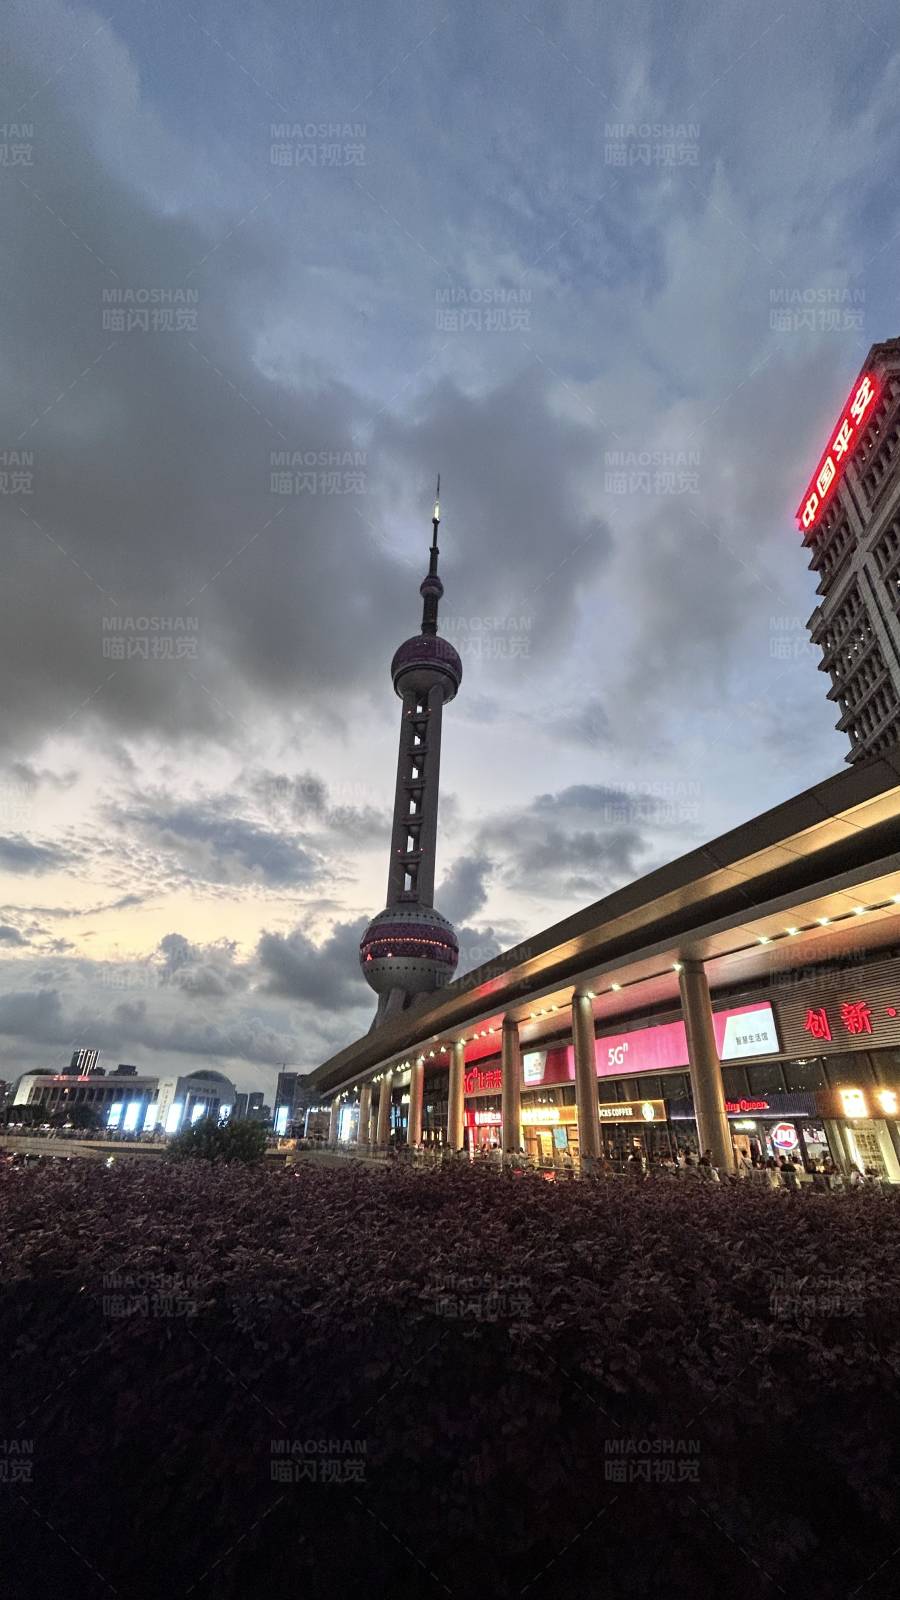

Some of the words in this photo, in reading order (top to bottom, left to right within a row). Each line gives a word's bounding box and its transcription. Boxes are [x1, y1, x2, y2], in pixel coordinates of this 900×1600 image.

[801, 376, 874, 528] 中国平安
[735, 1032, 769, 1045] 智慧生活馆
[740, 1100, 768, 1111] Queen
[612, 1108, 633, 1117] COFFEE
